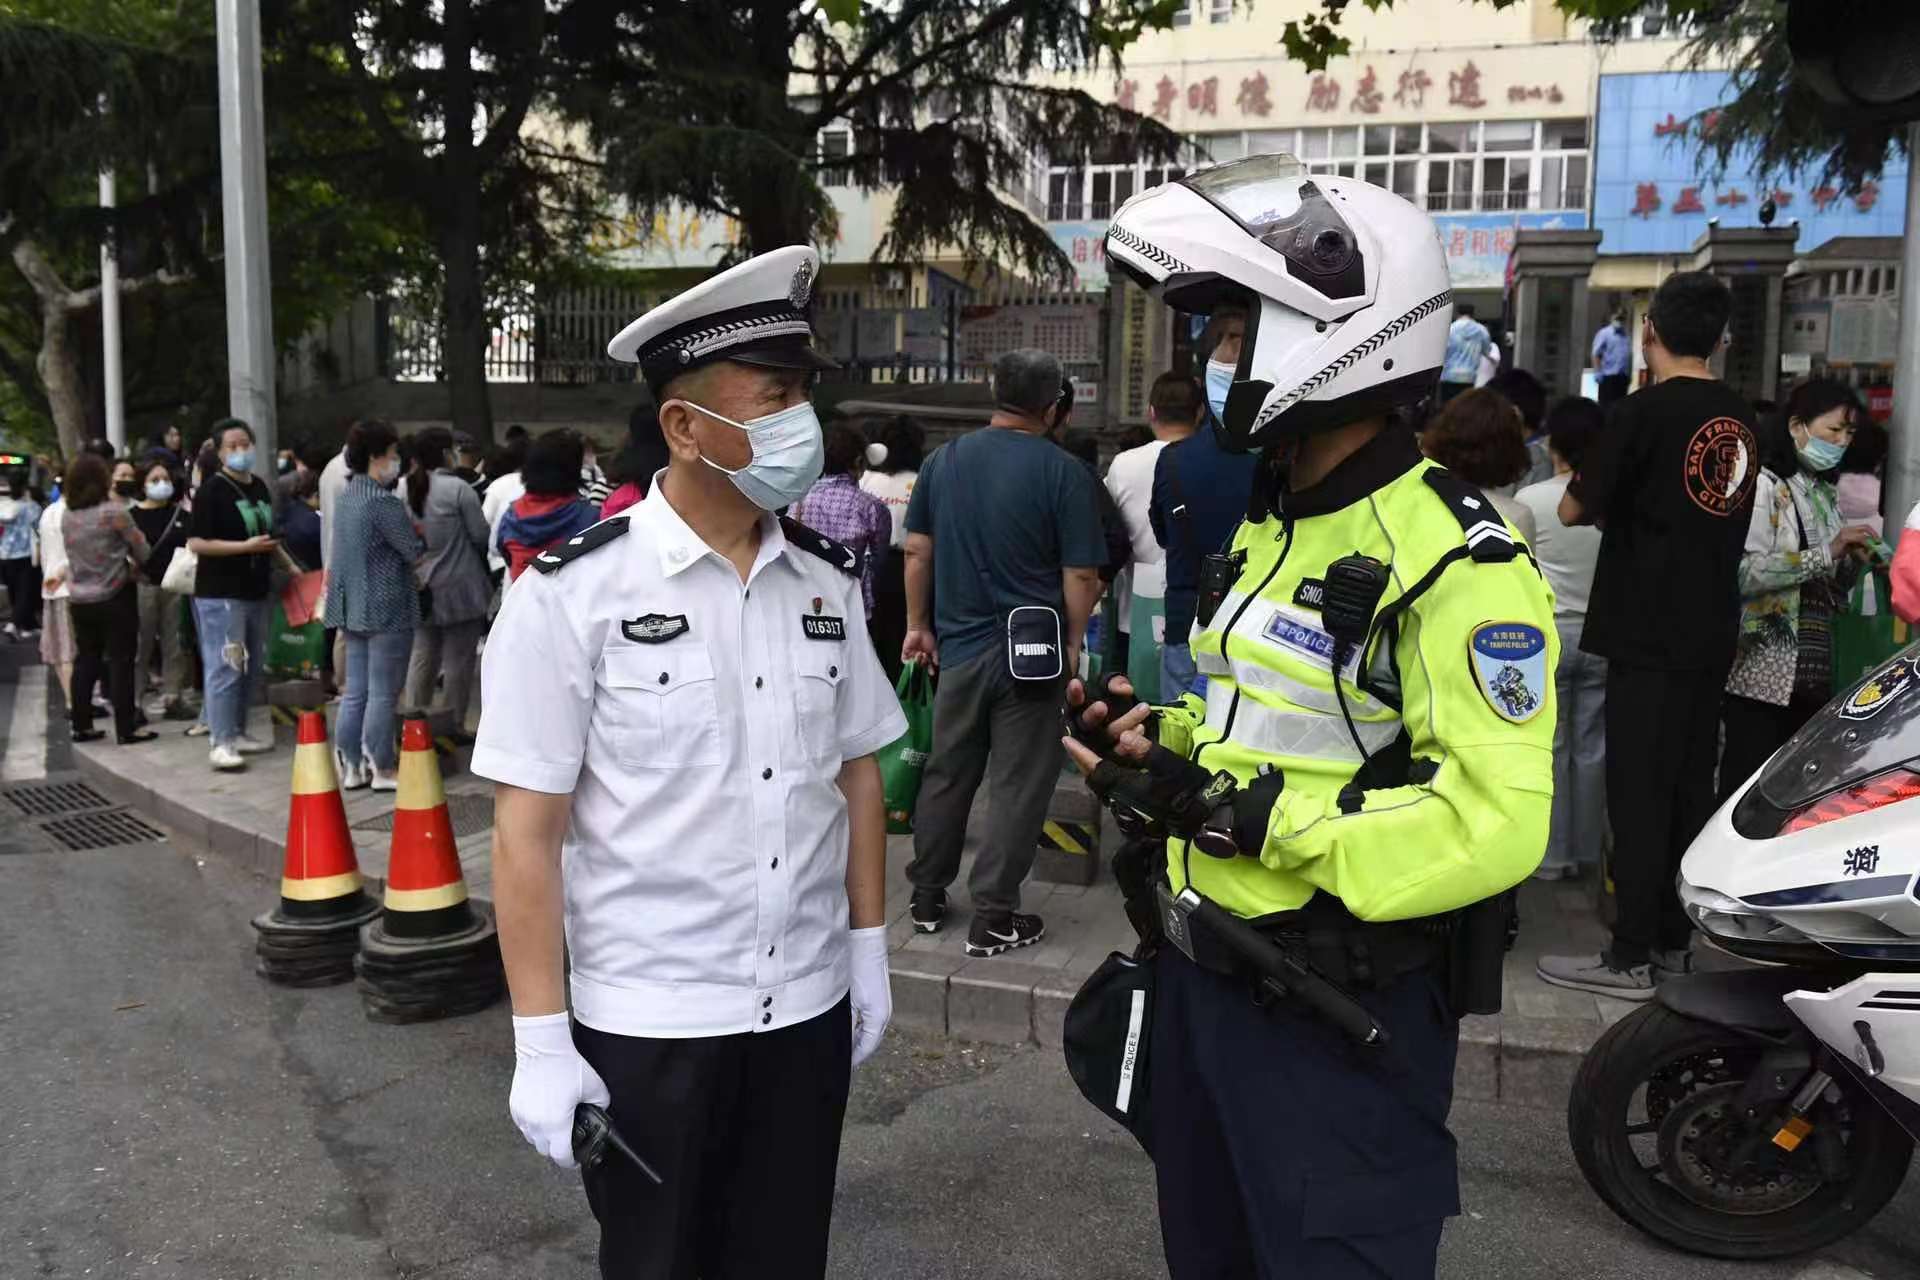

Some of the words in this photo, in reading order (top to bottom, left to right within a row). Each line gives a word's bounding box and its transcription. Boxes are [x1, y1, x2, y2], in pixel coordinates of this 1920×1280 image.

[1688, 440, 1704, 476] SAN
[806, 619, 842, 636] 016317
[1287, 627, 1334, 655] POLICE
[1015, 643, 1047, 656] PUMA
[1490, 641, 1511, 649] TRAFFIC
[1511, 641, 1529, 649] POLICE
[1843, 845, 1880, 876] 察
[1124, 1040, 1137, 1071] POLICE
